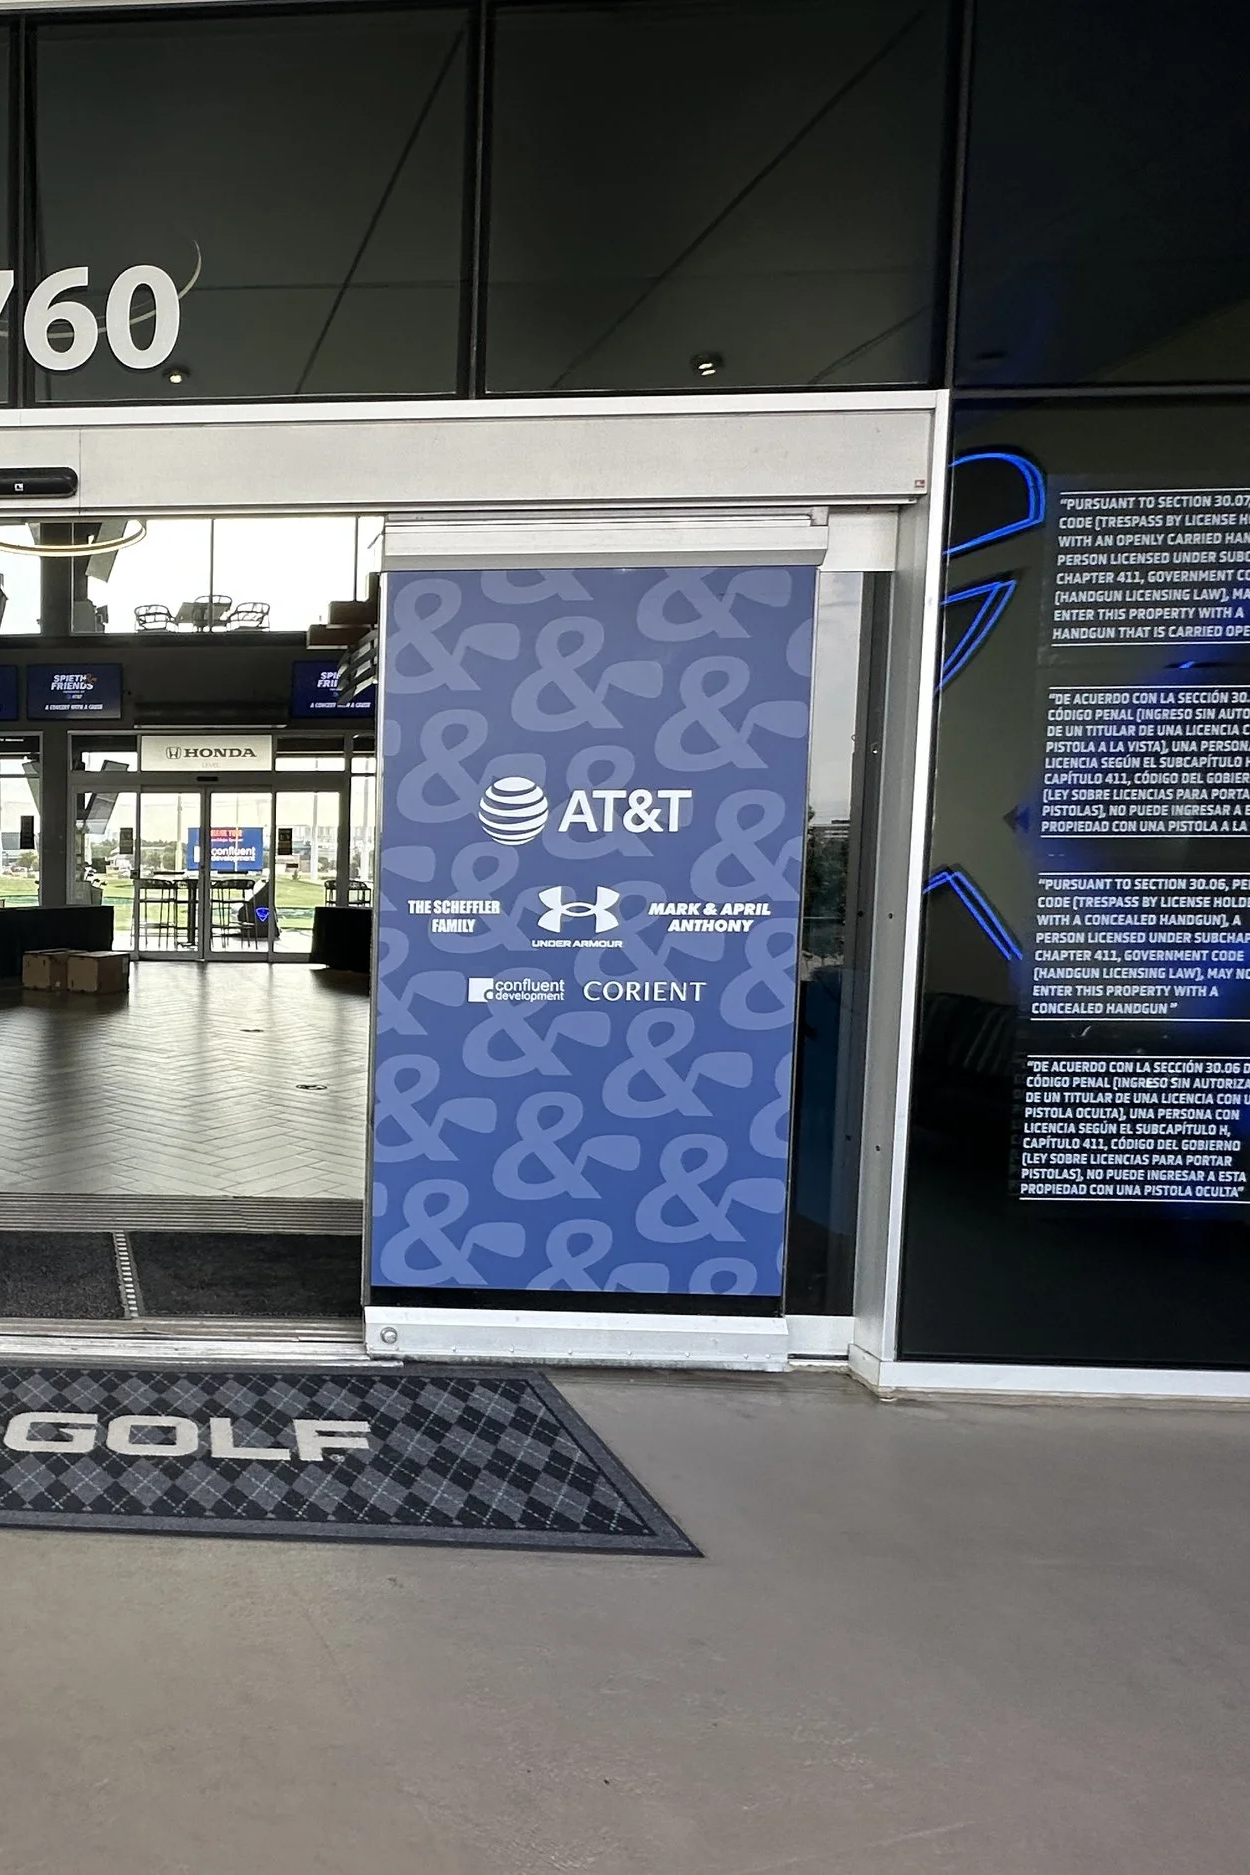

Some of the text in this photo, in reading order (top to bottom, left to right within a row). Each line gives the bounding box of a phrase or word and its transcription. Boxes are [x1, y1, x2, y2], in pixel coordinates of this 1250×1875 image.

[1137, 496, 1155, 508] TO
[1157, 495, 1211, 507] SECTION
[1057, 532, 1250, 547] WITH AN OPENLY CARRIED HAN
[1057, 553, 1107, 565] PERSON
[1110, 552, 1169, 564] LICENSED
[1173, 551, 1216, 563] UNDER
[1056, 571, 1114, 584] CHAPTER
[1116, 571, 1144, 584] 411,
[1147, 569, 1234, 582] GOVERNMENT
[53, 674, 87, 683] SPIETH
[50, 682, 94, 690] FRIENDS
[1073, 693, 1129, 704] ACUERDO
[1132, 692, 1157, 703] CON
[1159, 692, 1175, 703] LA
[1177, 690, 1228, 703] SECCIÓN
[184, 748, 257, 758] HONDA
[1045, 757, 1098, 768] LICENCIA
[1100, 754, 1140, 768] SEGÚN
[1143, 756, 1157, 767] EL
[1158, 754, 1242, 767] SUBCAPÍTULO
[1044, 771, 1103, 784] CAPÍTULO
[1104, 773, 1131, 785] 411,
[1133, 770, 1178, 783] CÓDIGO
[1181, 772, 1204, 783] DEL
[558, 789, 693, 834] AT&T
[210, 846, 256, 856] confluent
[1114, 878, 1131, 889] TO
[1133, 878, 1186, 889] SECTION
[1188, 878, 1229, 890] 30.06,
[408, 900, 500, 915] THE SCHEFFLER
[648, 903, 772, 917] MARK & APRIL
[431, 918, 476, 934] FAMILY
[667, 919, 754, 933] ANTHONY
[531, 940, 623, 948] UNDER ARMOUR
[1036, 932, 1084, 942] PERSON
[1087, 932, 1145, 943] LICENSED
[1148, 932, 1191, 943] UNDER
[1034, 949, 1244, 962] CHAPTER 411, GOVERNMENT CODE
[494, 977, 565, 992] confluent
[583, 981, 707, 1002] CORIENT
[1032, 985, 1218, 996] ENTER THIS PROPERTY WITH A
[494, 990, 565, 1003] development
[1023, 1120, 1230, 1136] LICENCIA SEGÚN EL SUBCAPÍTULO H,
[1022, 1135, 1241, 1151] CAPÍTULO 411, CÓDIGO DEL GOBIERNO
[1020, 1183, 1087, 1194] PROPIEDAD
[1089, 1184, 1113, 1195] CON
[1116, 1184, 1141, 1195] UNA
[1143, 1185, 1192, 1196] PISTOLA
